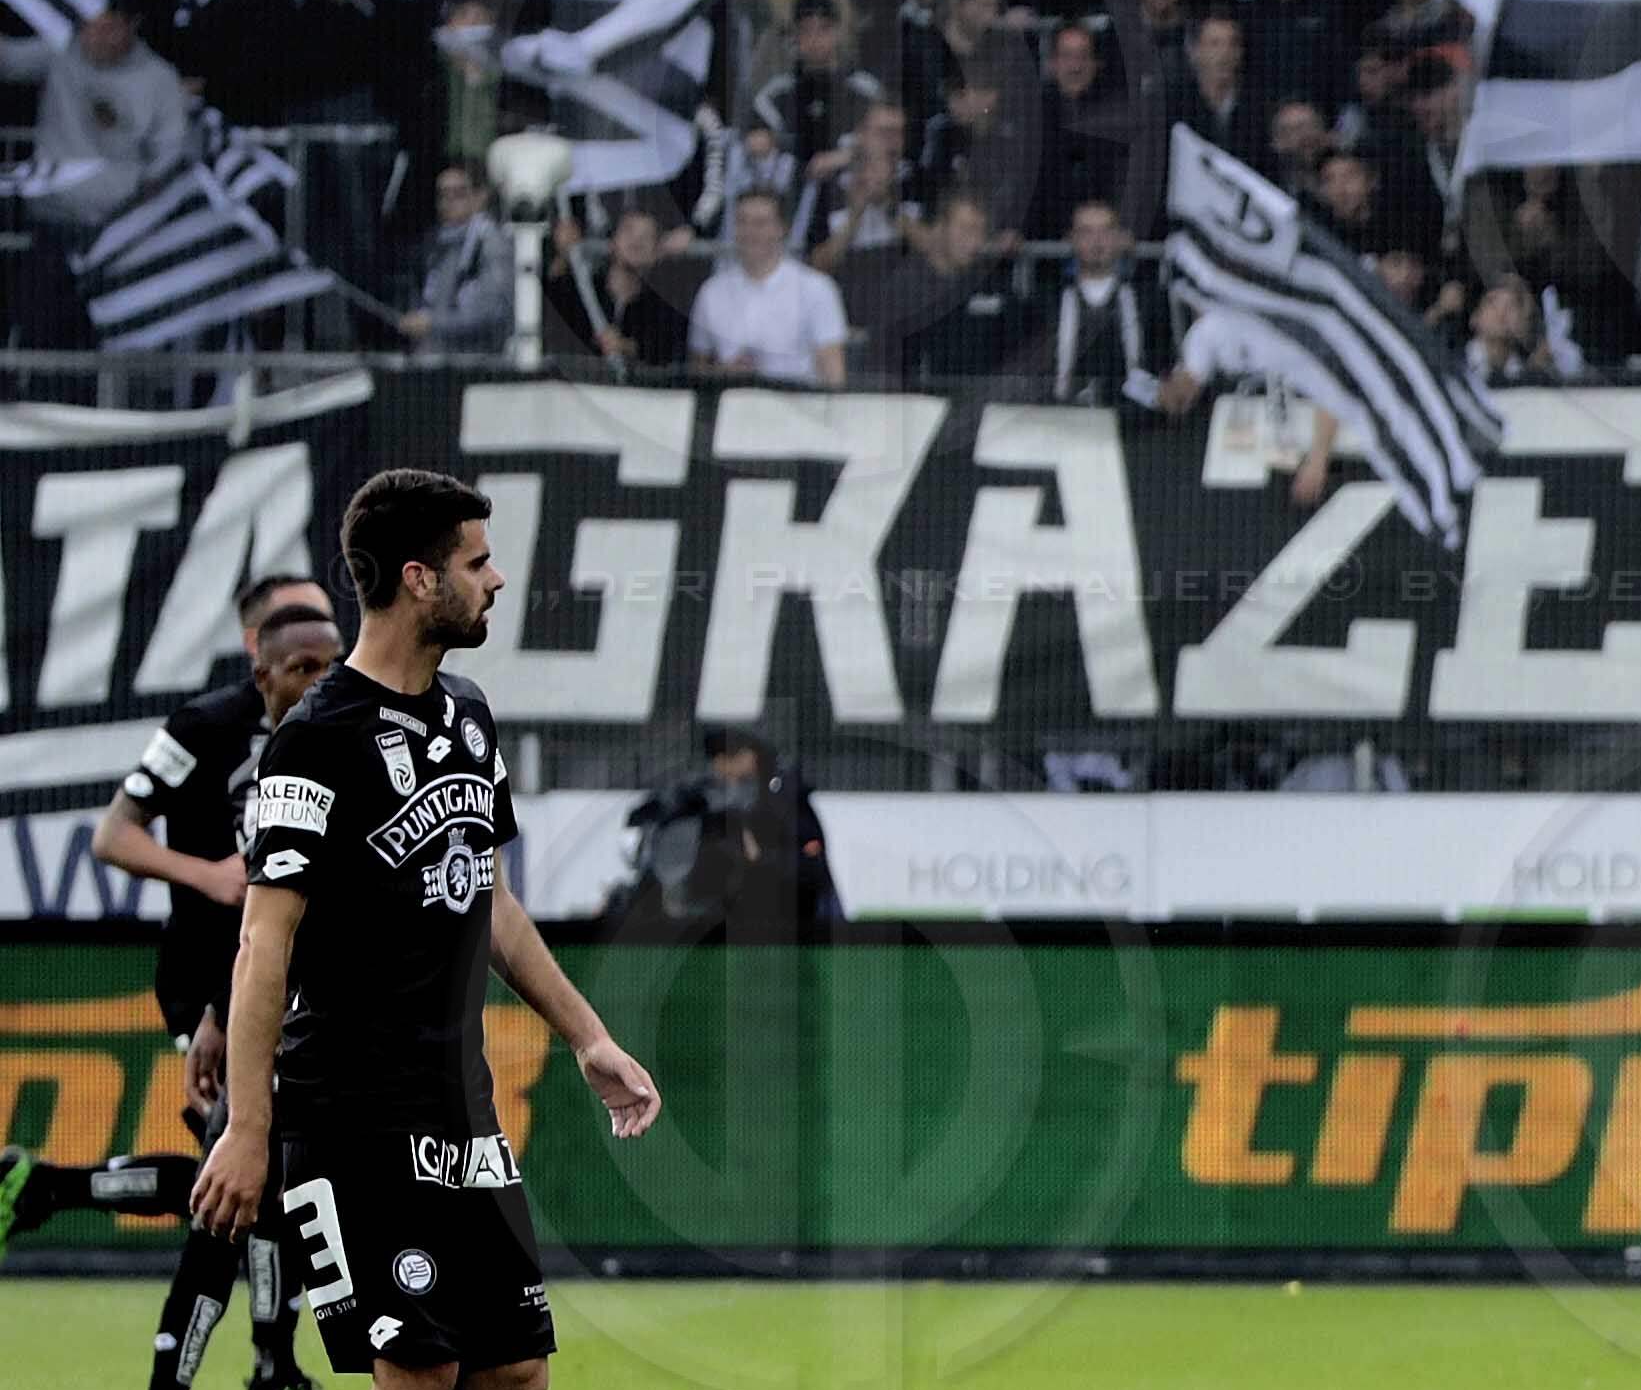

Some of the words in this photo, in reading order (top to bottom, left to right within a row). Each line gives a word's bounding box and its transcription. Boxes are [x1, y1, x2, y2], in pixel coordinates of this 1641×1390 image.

[0, 441, 313, 711] TA
[261, 782, 331, 813] KLEINE
[382, 782, 495, 857] PUNTIGAME
